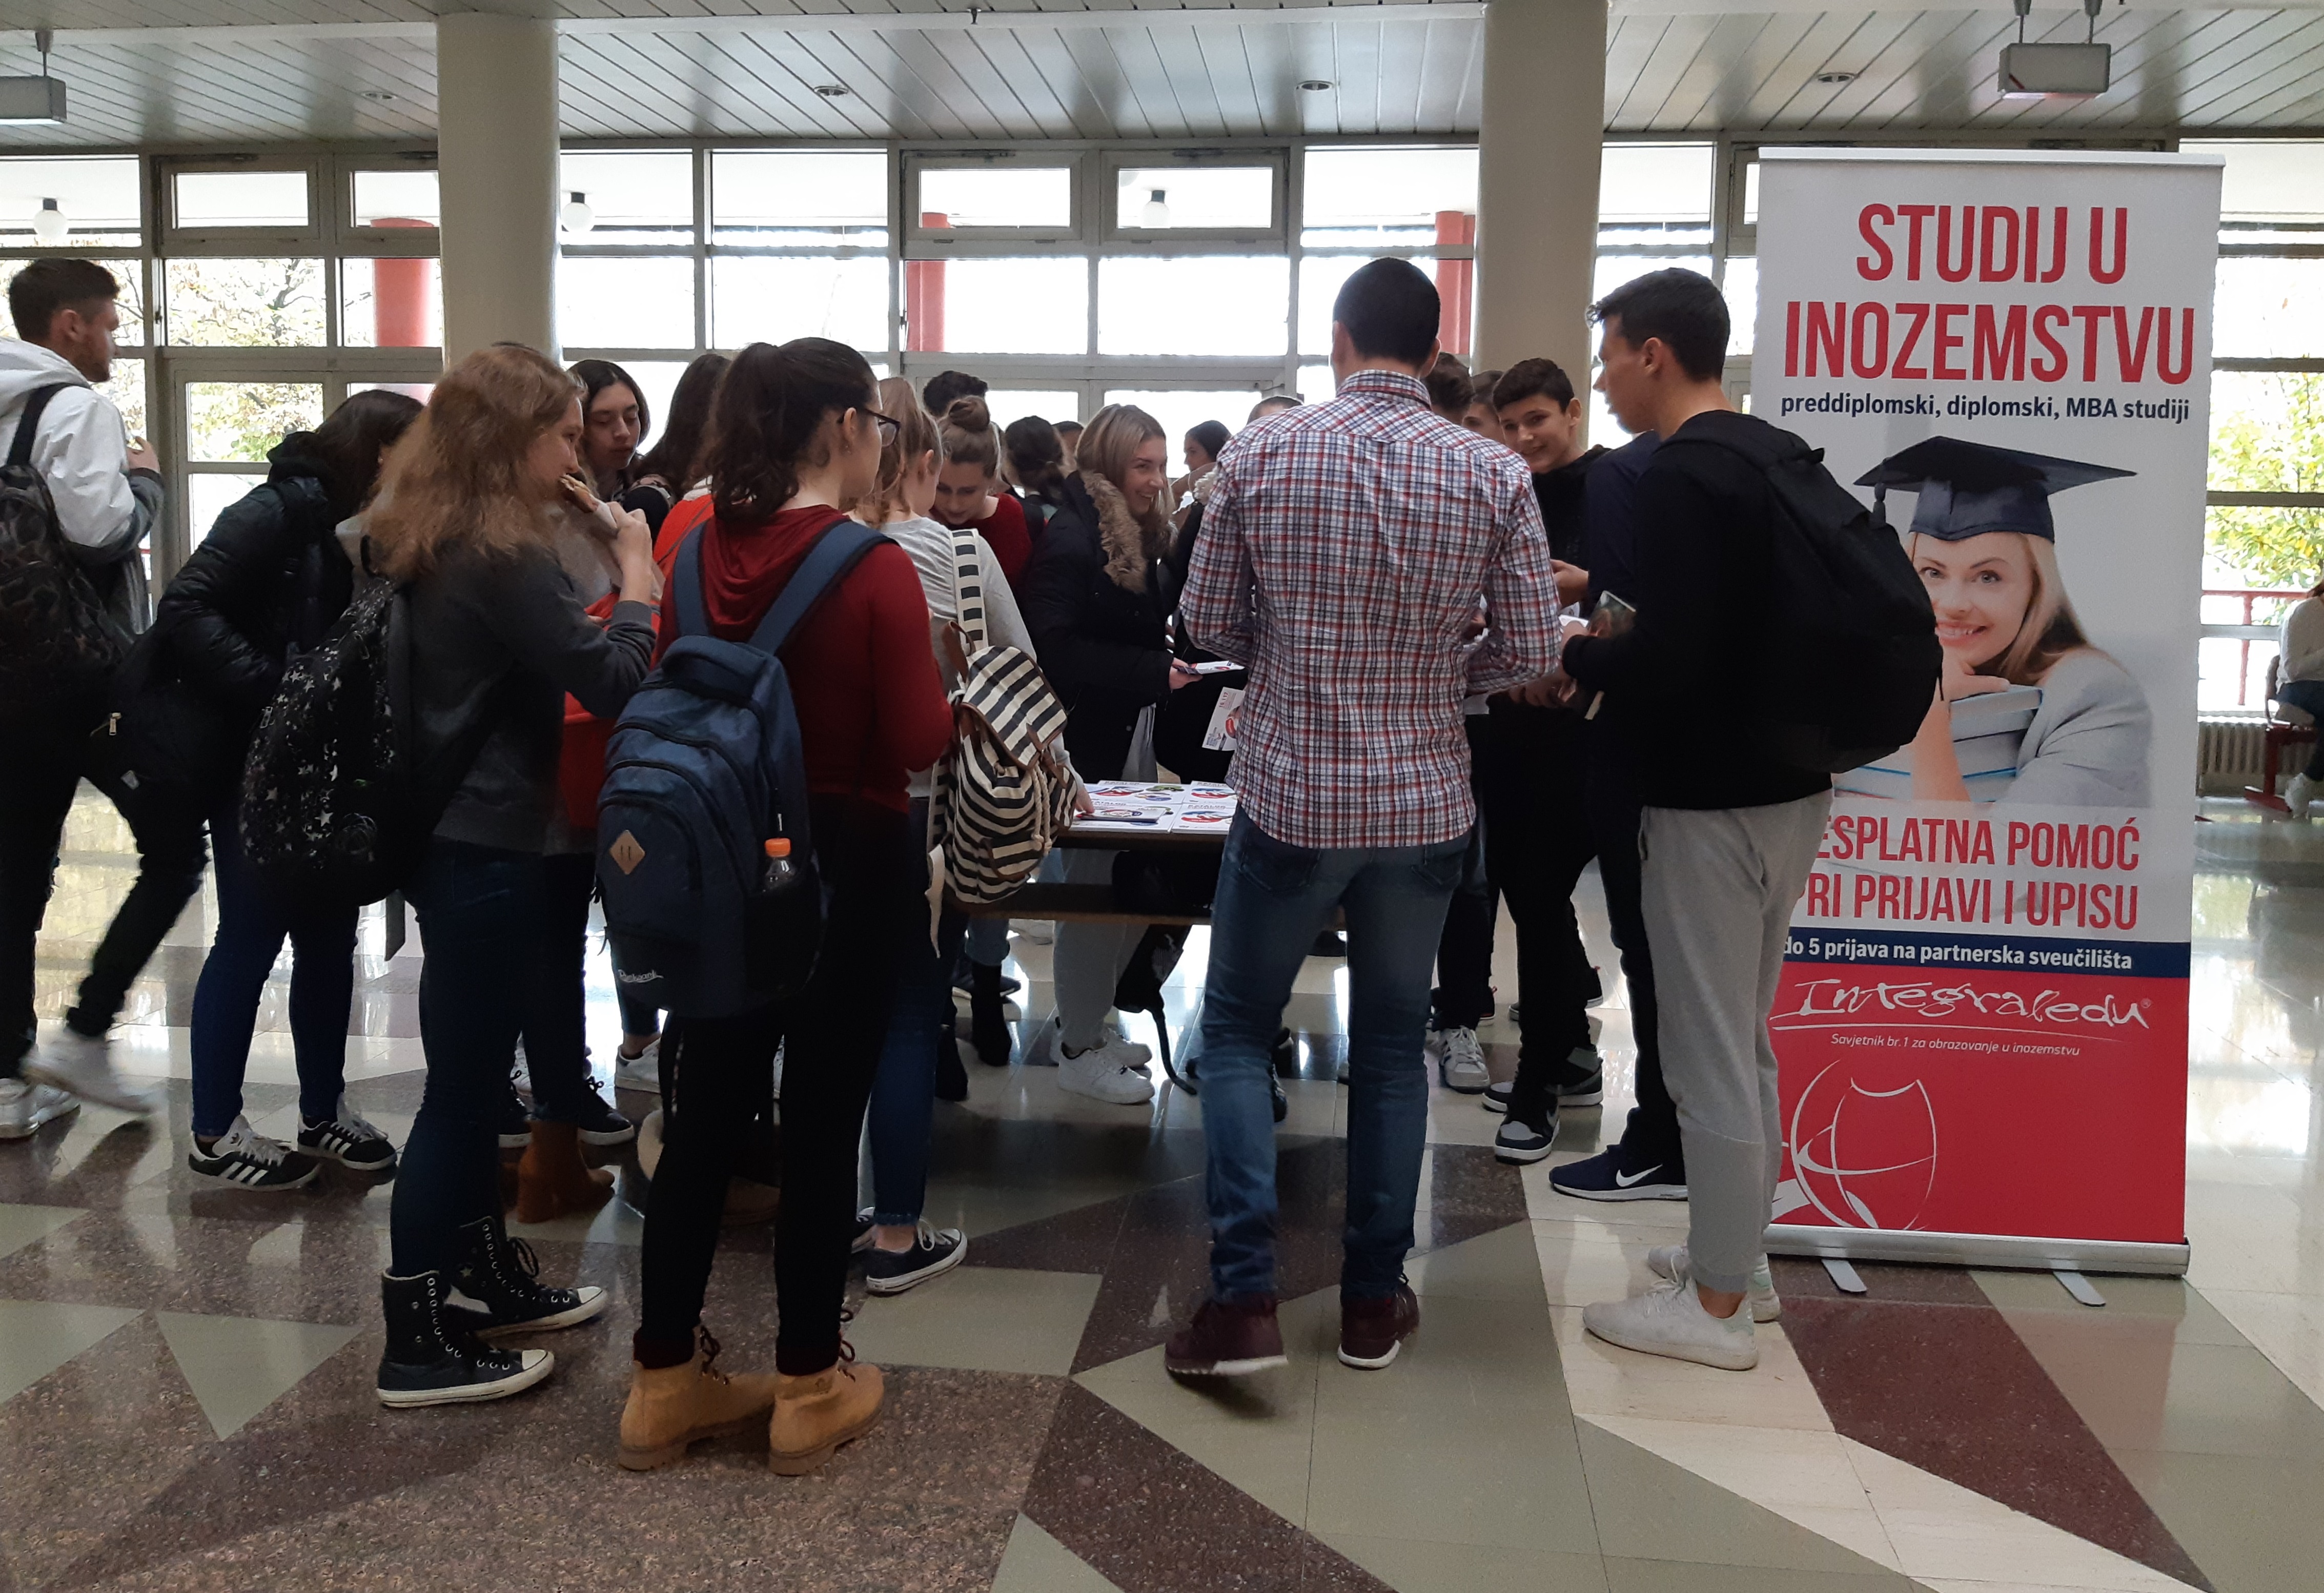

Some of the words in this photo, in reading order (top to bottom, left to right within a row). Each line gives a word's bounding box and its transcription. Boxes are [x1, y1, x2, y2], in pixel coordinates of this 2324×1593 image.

[1856, 203, 2068, 282] STUDIJ
[2089, 208, 2127, 283] U
[1784, 301, 2194, 384] INOZEMSTVU
[1782, 393, 1940, 418] preddiplomski,
[1948, 395, 2059, 420] diplomski,
[2067, 398, 2117, 417] MBA
[2124, 399, 2189, 424] studiji
[1816, 815, 1995, 865] SPLATNA
[2007, 817, 2139, 871] POMOĆ
[1799, 872, 1842, 916] RI
[1854, 874, 1991, 923] PRIJAVI
[2004, 880, 2013, 924] I
[2026, 881, 2138, 930] UPISU
[1808, 938, 1820, 955] 5
[1825, 939, 1888, 960] prijava
[1894, 946, 1914, 958] na
[1920, 944, 2024, 964] partnerska
[2029, 949, 2131, 968] sveučilišta
[1831, 1033, 1885, 1048] Savjetnik
[1911, 1039, 1926, 1048] za
[1929, 1038, 1999, 1054] obrazovanje
[2013, 1043, 2080, 1055] inozemstvu
